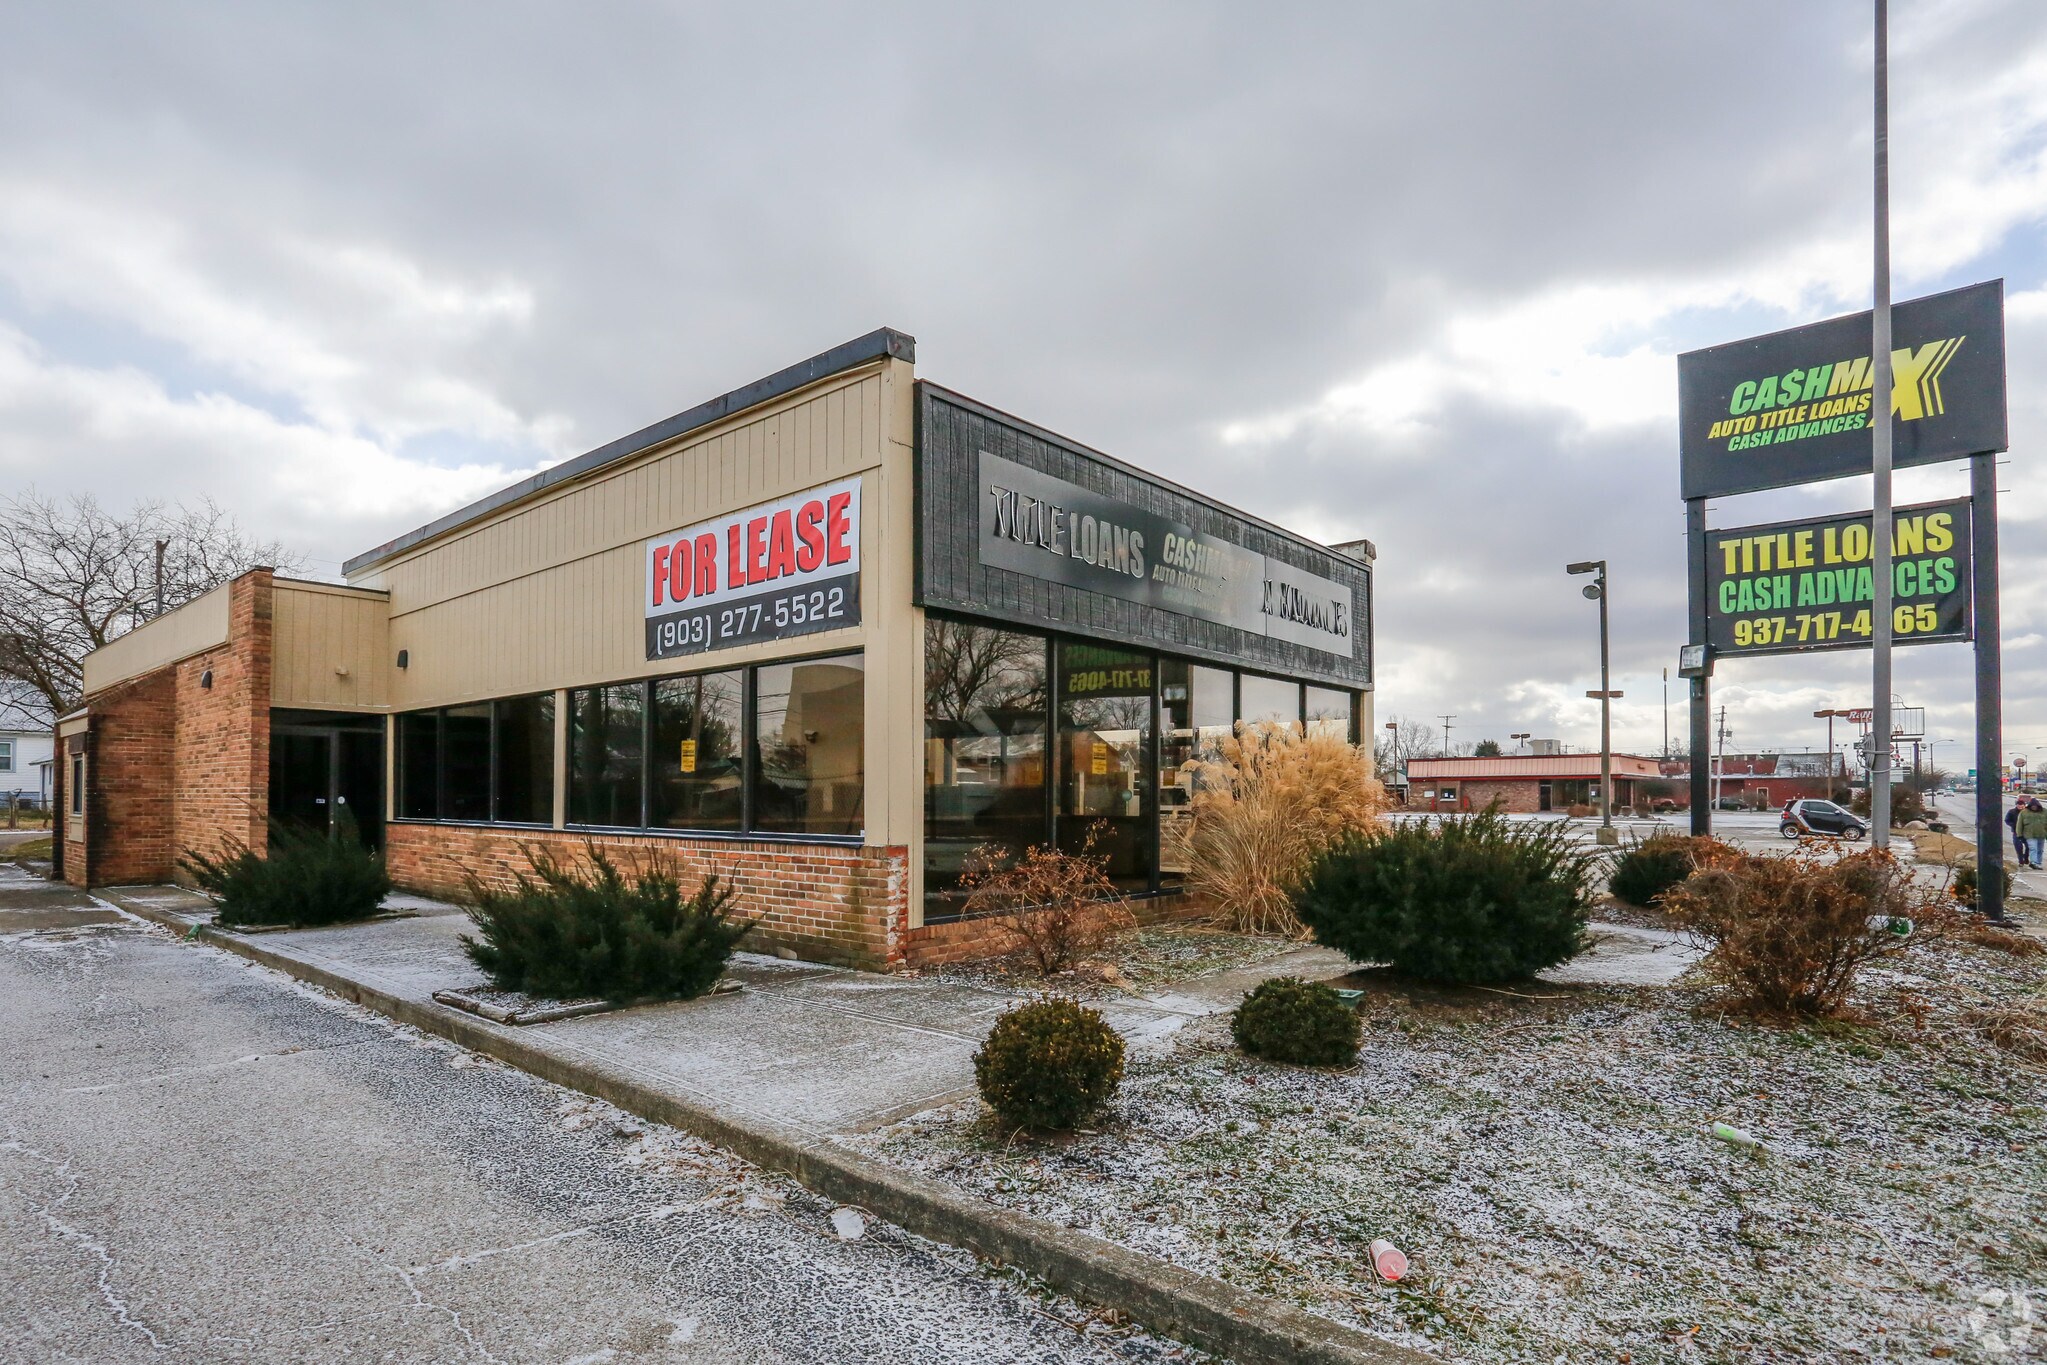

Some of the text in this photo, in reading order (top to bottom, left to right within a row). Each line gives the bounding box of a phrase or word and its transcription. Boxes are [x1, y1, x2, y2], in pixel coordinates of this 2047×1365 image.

[1708, 393, 1872, 439] AUTO TITLE LOANS
[1728, 413, 1866, 451] CASH ADVANCES
[653, 491, 851, 607] FOR LEASE
[990, 484, 1144, 578] TITLE LOANS
[1719, 530, 1814, 575] TITLE
[1152, 564, 1176, 584] AUTO
[1719, 557, 1955, 614] CASH ADVACES
[657, 586, 844, 655] (903) 277-5522
[1734, 603, 1937, 646] 937-717-465
